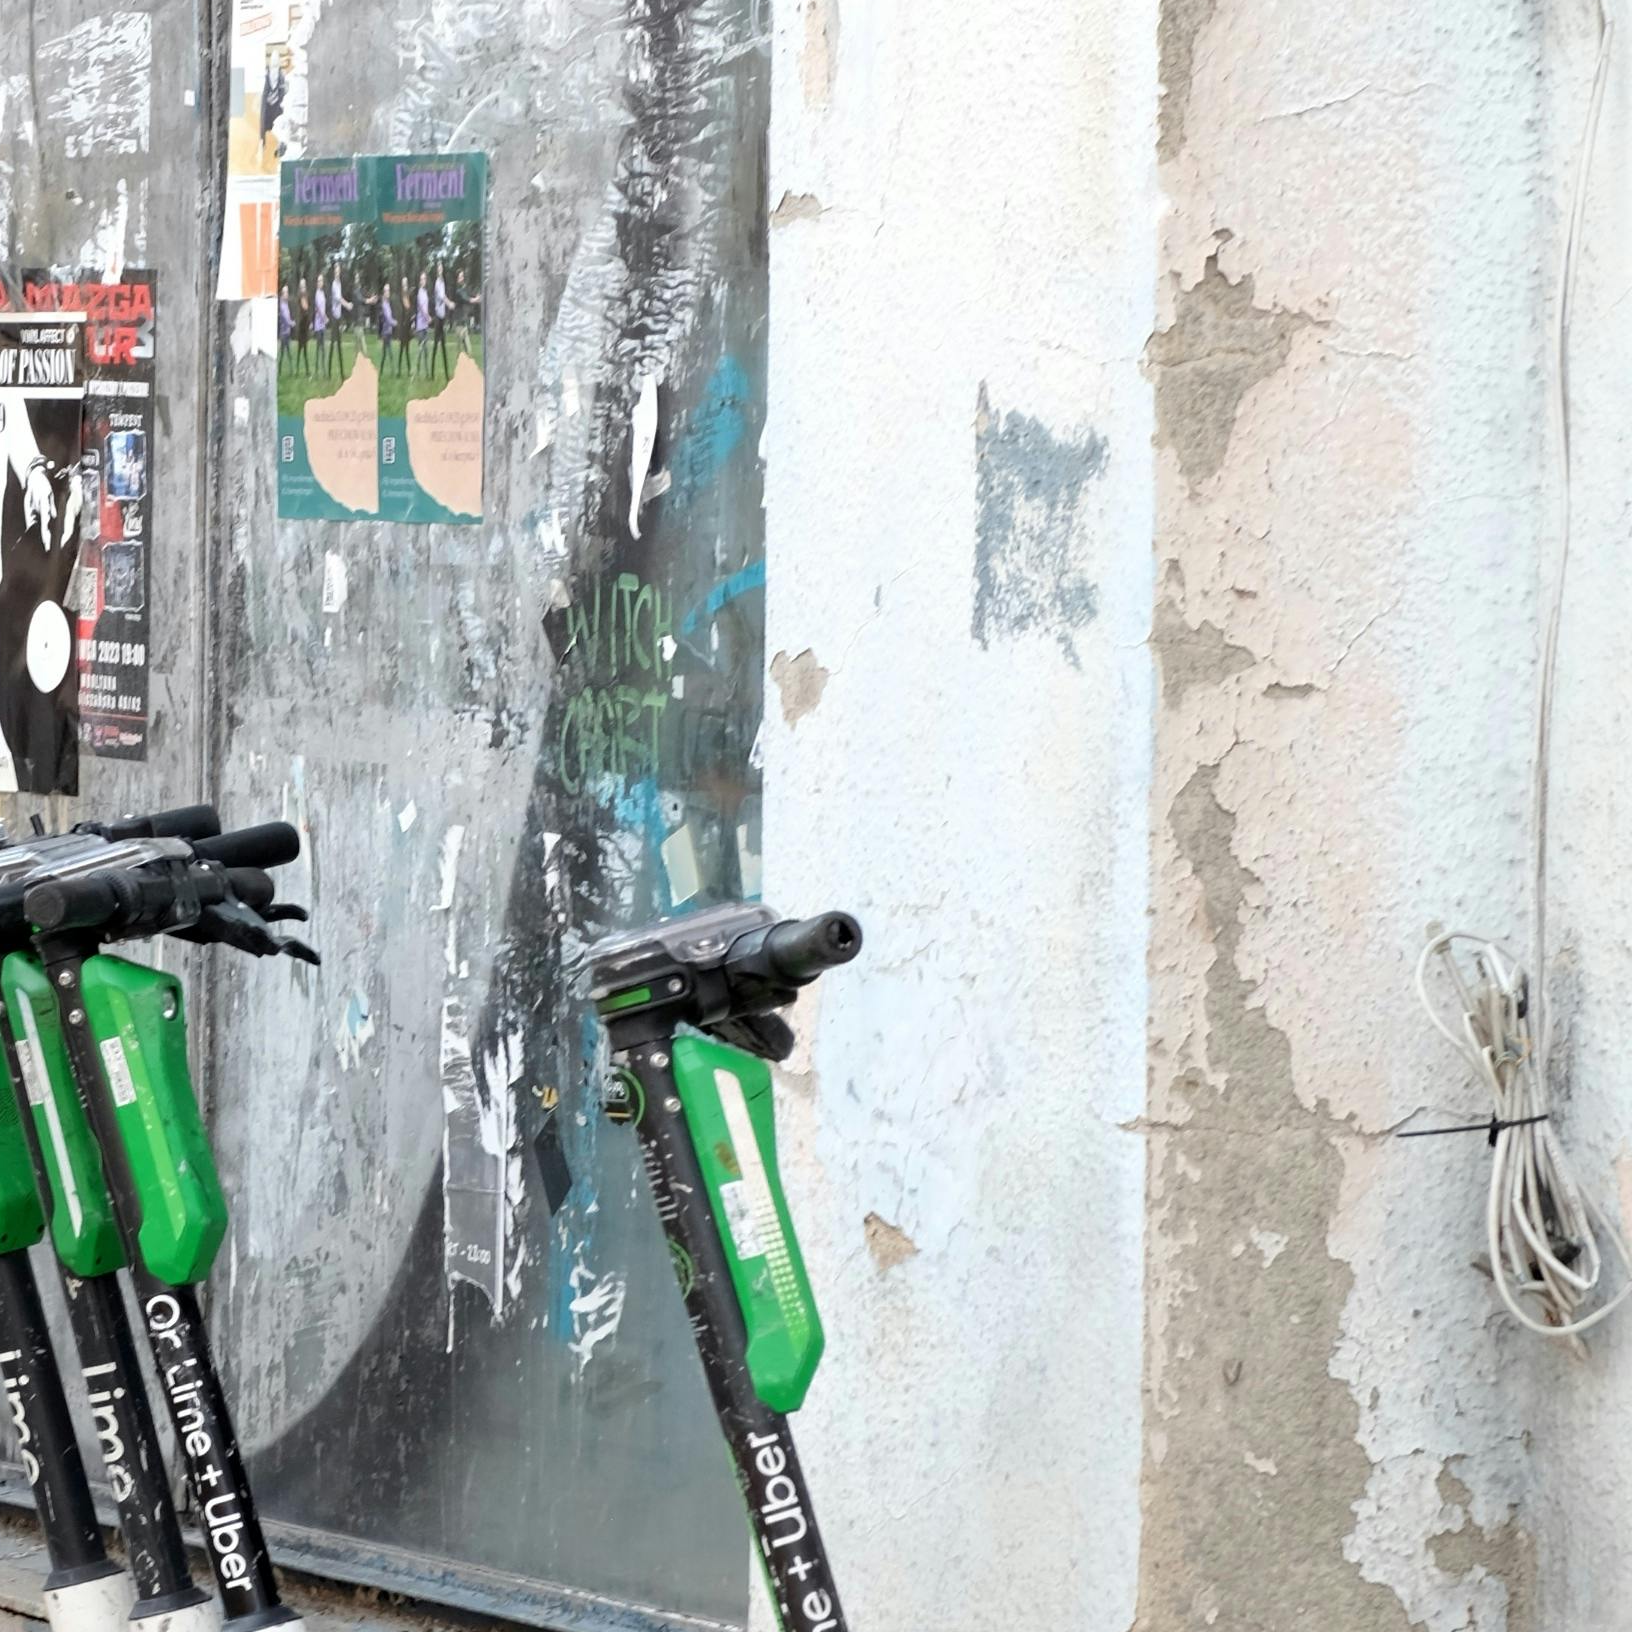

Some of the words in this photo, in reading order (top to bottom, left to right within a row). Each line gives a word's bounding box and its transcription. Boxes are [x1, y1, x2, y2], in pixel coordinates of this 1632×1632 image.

[294, 168, 358, 205] Ferment
[395, 163, 465, 203] Ferment
[18, 348, 77, 384] PASSION
[81, 1361, 135, 1503] Lime
[167, 1357, 212, 1458] Lime
[204, 1492, 253, 1592] Uber
[746, 1431, 807, 1548] Uber
